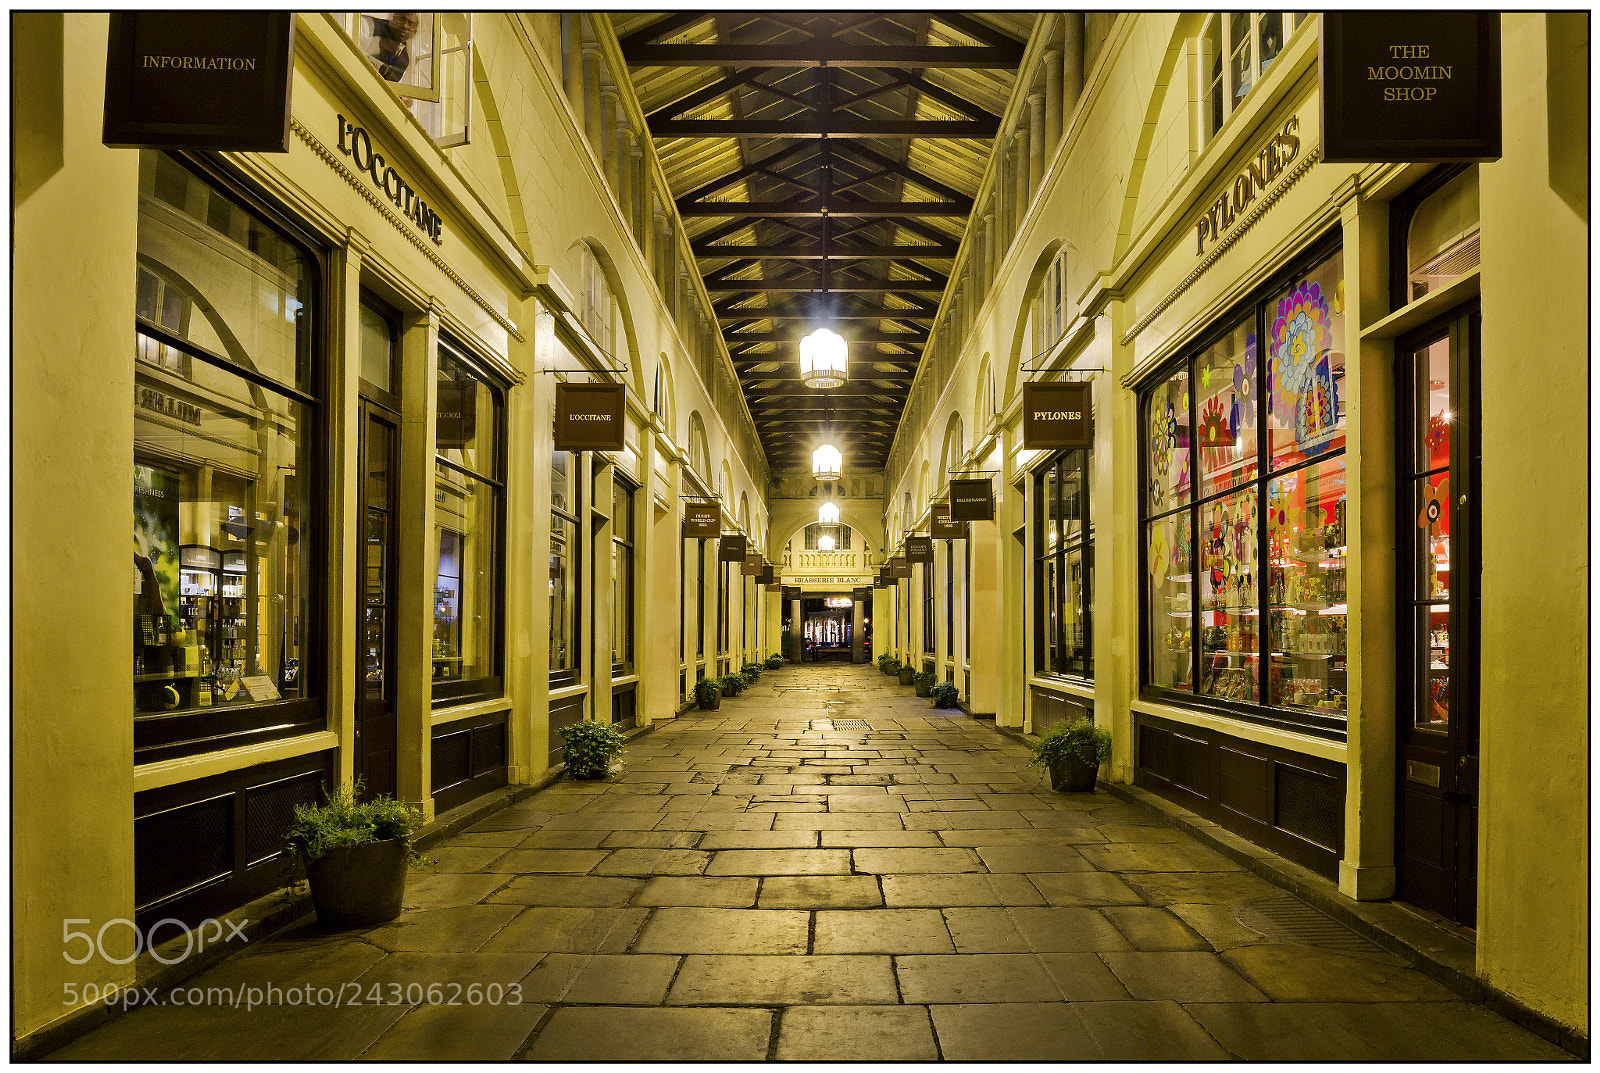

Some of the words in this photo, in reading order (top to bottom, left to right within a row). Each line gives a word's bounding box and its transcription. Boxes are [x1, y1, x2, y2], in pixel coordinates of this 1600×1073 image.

[1389, 45, 1430, 59] THE
[142, 55, 256, 71] INFORMATION
[1367, 65, 1453, 80] MOOMIN
[1384, 87, 1437, 101] SHOP
[336, 113, 443, 247] L'OCCITANE
[1195, 114, 1300, 256] PYLONES
[569, 414, 612, 422] L'OCCITANE
[1033, 411, 1082, 421] PYLONES
